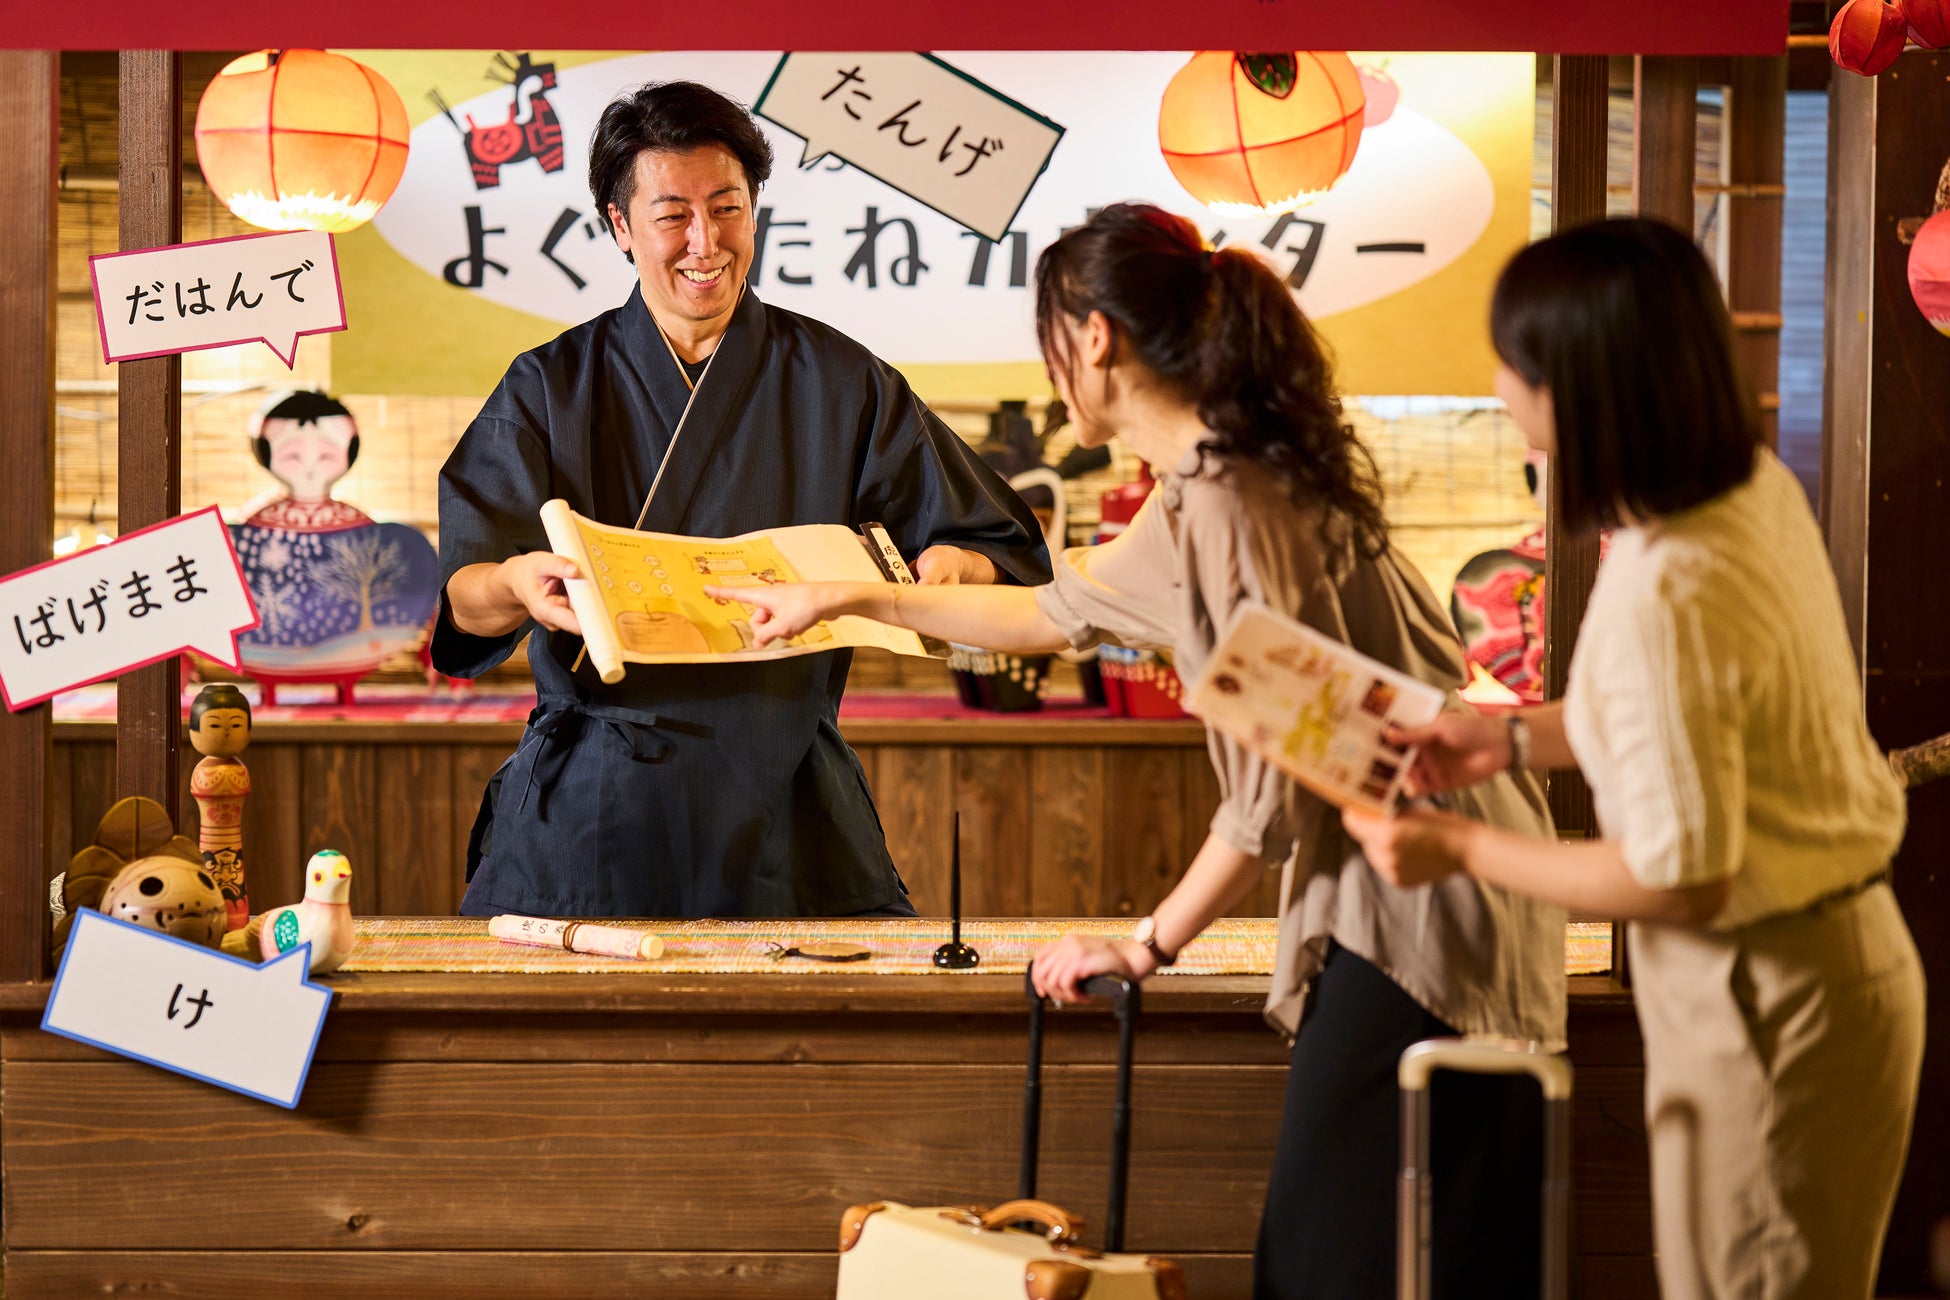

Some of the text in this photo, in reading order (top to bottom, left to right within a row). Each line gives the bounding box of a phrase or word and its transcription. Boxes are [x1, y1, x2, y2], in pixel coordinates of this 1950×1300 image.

[820, 66, 1005, 178] たんげ
[125, 258, 314, 325] だはんで
[13, 554, 209, 655] ばげまま
[167, 983, 214, 1029] け
